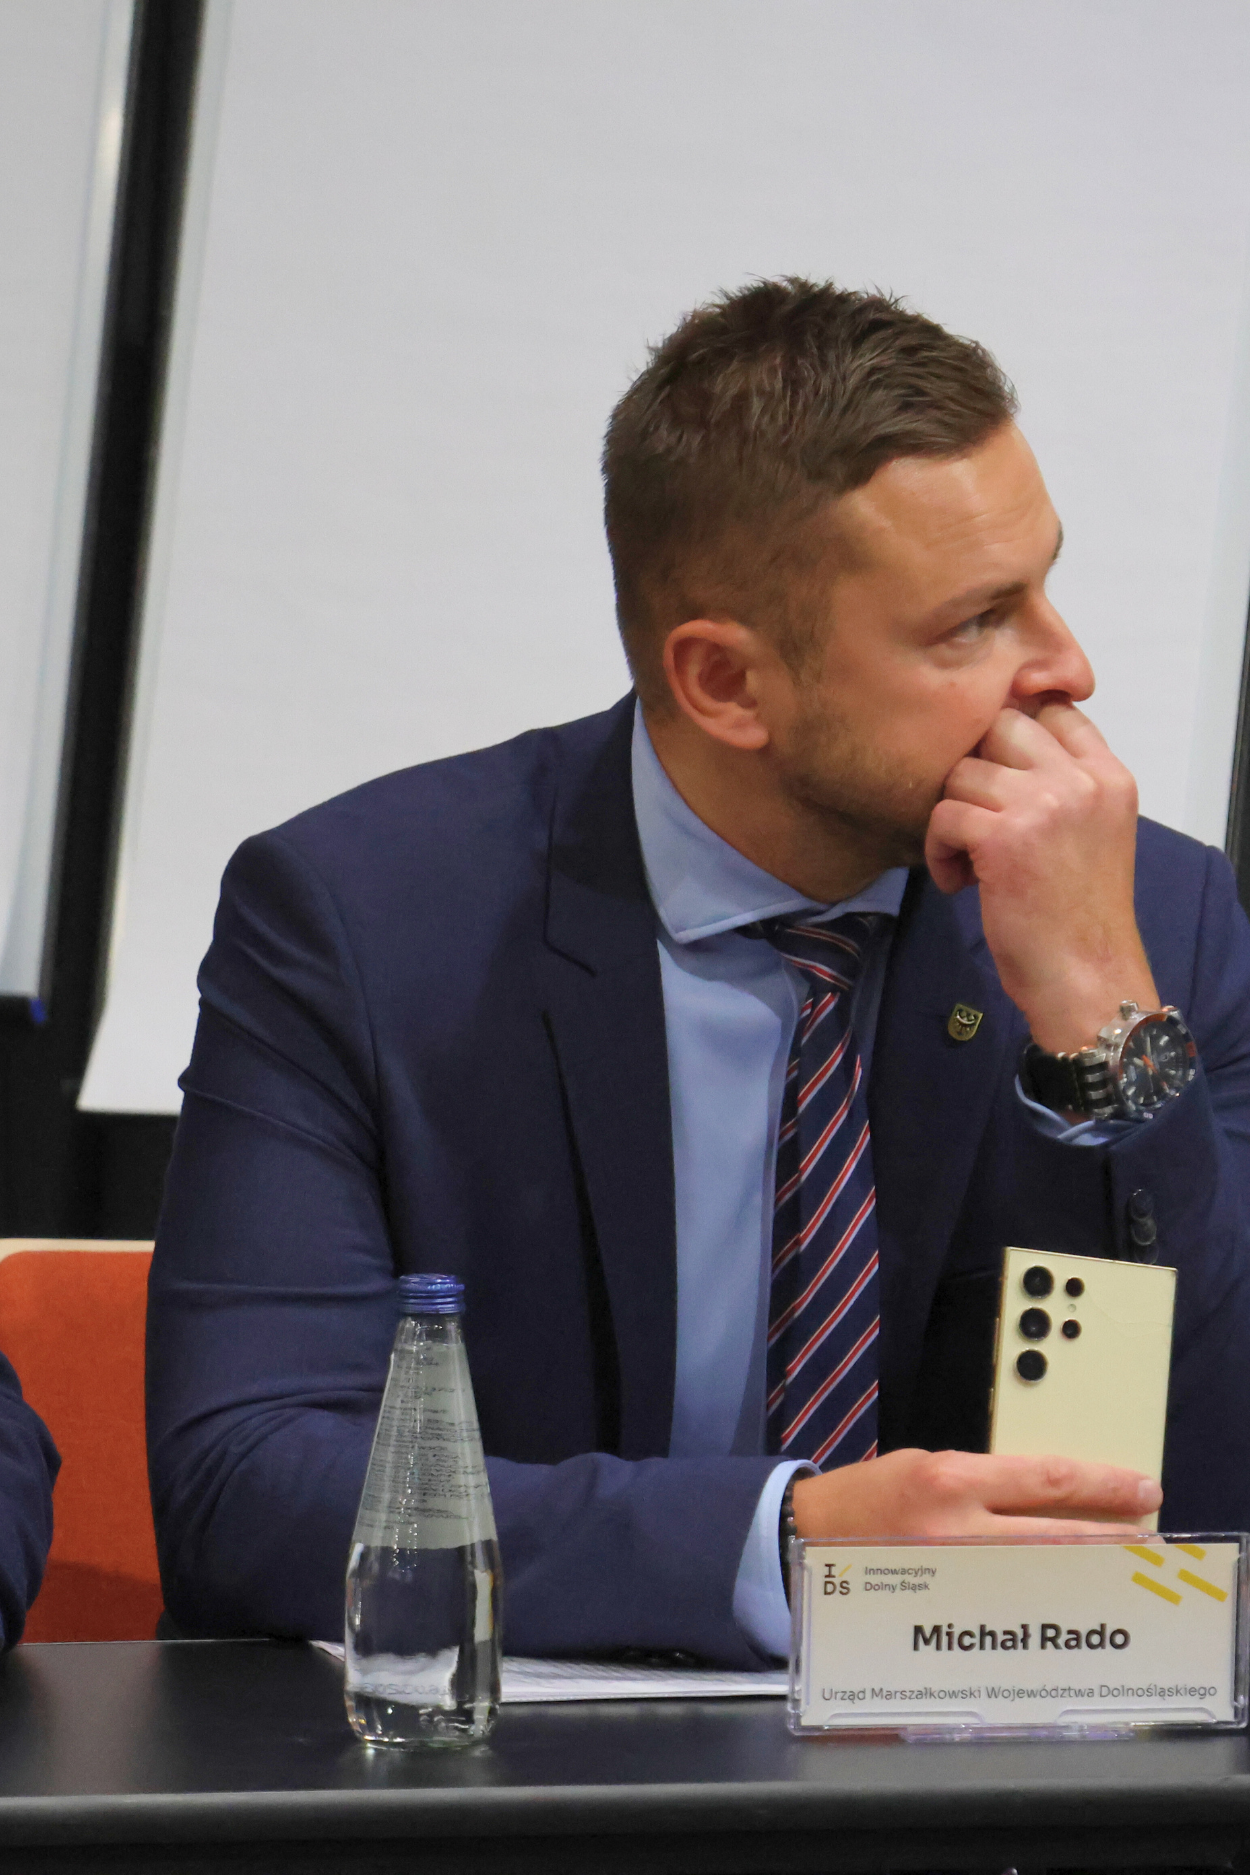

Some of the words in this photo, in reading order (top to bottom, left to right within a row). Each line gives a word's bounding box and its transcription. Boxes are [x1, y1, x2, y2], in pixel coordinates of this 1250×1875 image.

[865, 1565, 937, 1577] Innowacyjny
[864, 1582, 897, 1593] Dolny
[900, 1579, 930, 1593] Śląsk
[913, 1623, 1031, 1651] Michał
[1040, 1623, 1130, 1650] Rado
[822, 1688, 866, 1703] Urząd
[871, 1687, 981, 1700] Marszałkowski
[986, 1685, 1094, 1701] Województwa
[1099, 1683, 1217, 1699] Dolnośląskiego
